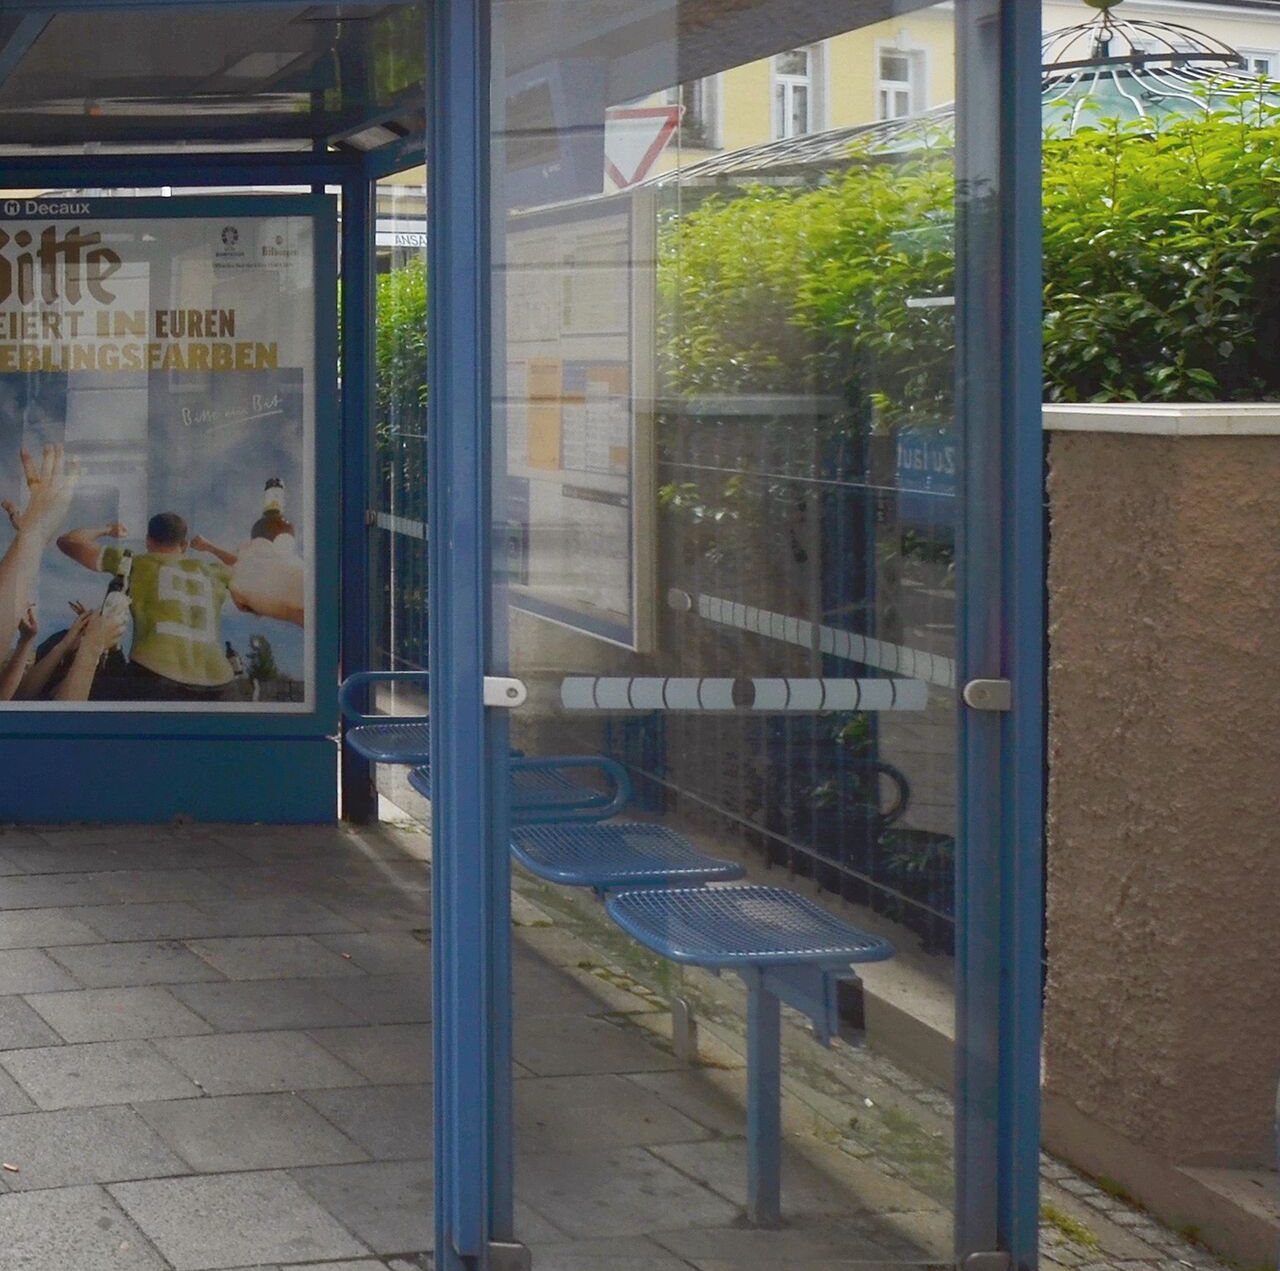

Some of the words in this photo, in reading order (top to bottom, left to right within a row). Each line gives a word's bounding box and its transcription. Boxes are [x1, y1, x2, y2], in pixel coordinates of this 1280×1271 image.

[25, 201, 90, 215] Decaux
[97, 309, 146, 337] IN
[155, 308, 236, 338] EUREN
